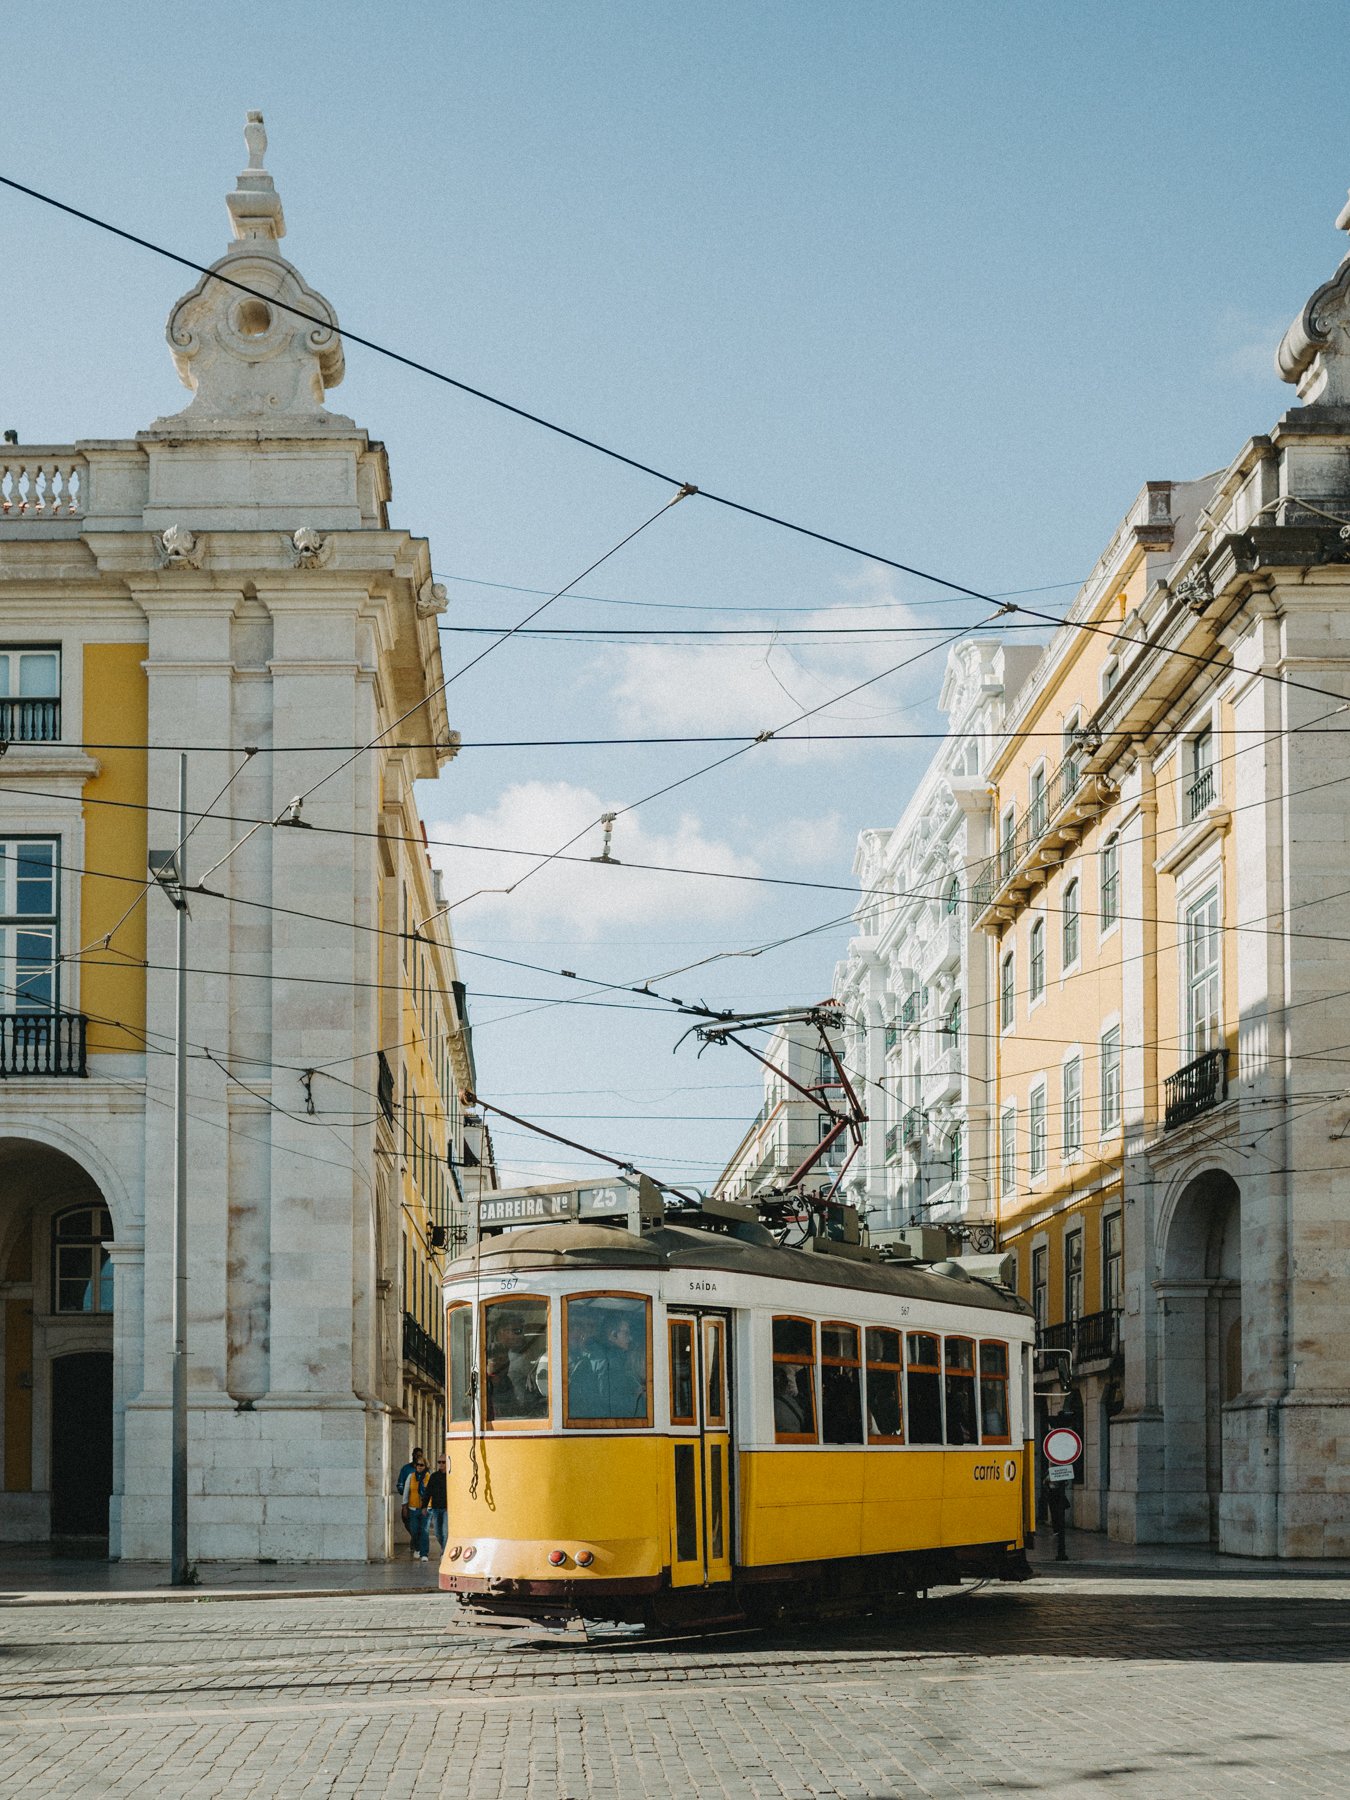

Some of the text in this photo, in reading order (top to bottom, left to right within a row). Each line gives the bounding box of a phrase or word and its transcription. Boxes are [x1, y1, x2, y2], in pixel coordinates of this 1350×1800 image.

[480, 1198, 544, 1220] CARREIRA
[592, 1189, 617, 1209] 25
[501, 1278, 518, 1290] 567
[689, 1280, 717, 1291] SAÍDA
[901, 1306, 909, 1316] 567
[973, 1459, 1000, 1480] carris
